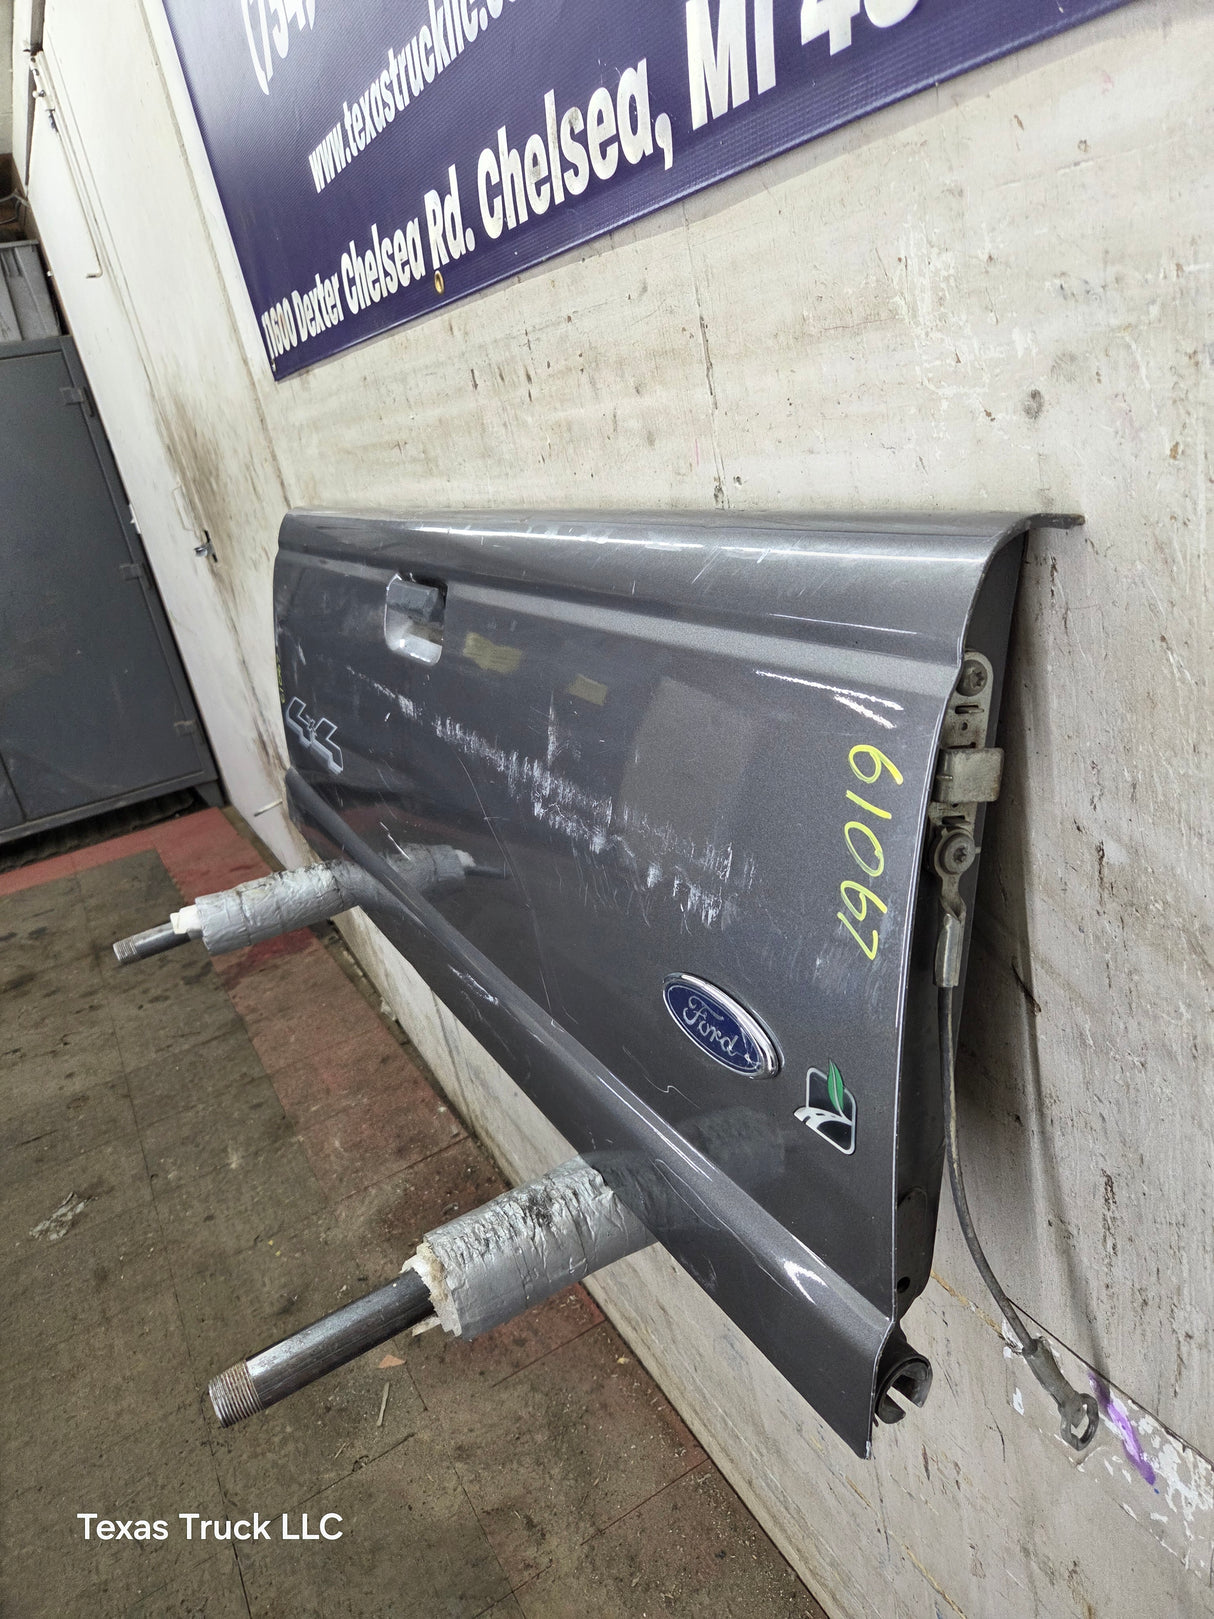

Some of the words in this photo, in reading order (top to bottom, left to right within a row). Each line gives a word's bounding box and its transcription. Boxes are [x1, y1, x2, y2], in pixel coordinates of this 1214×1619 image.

[291, 272, 345, 343] Dexter
[341, 217, 426, 315] Chelsea
[423, 164, 476, 270] Rd.
[477, 57, 674, 239] Chelsea,
[685, 0, 776, 131] MI
[837, 744, 903, 960] 61067
[682, 995, 741, 1057] Ford
